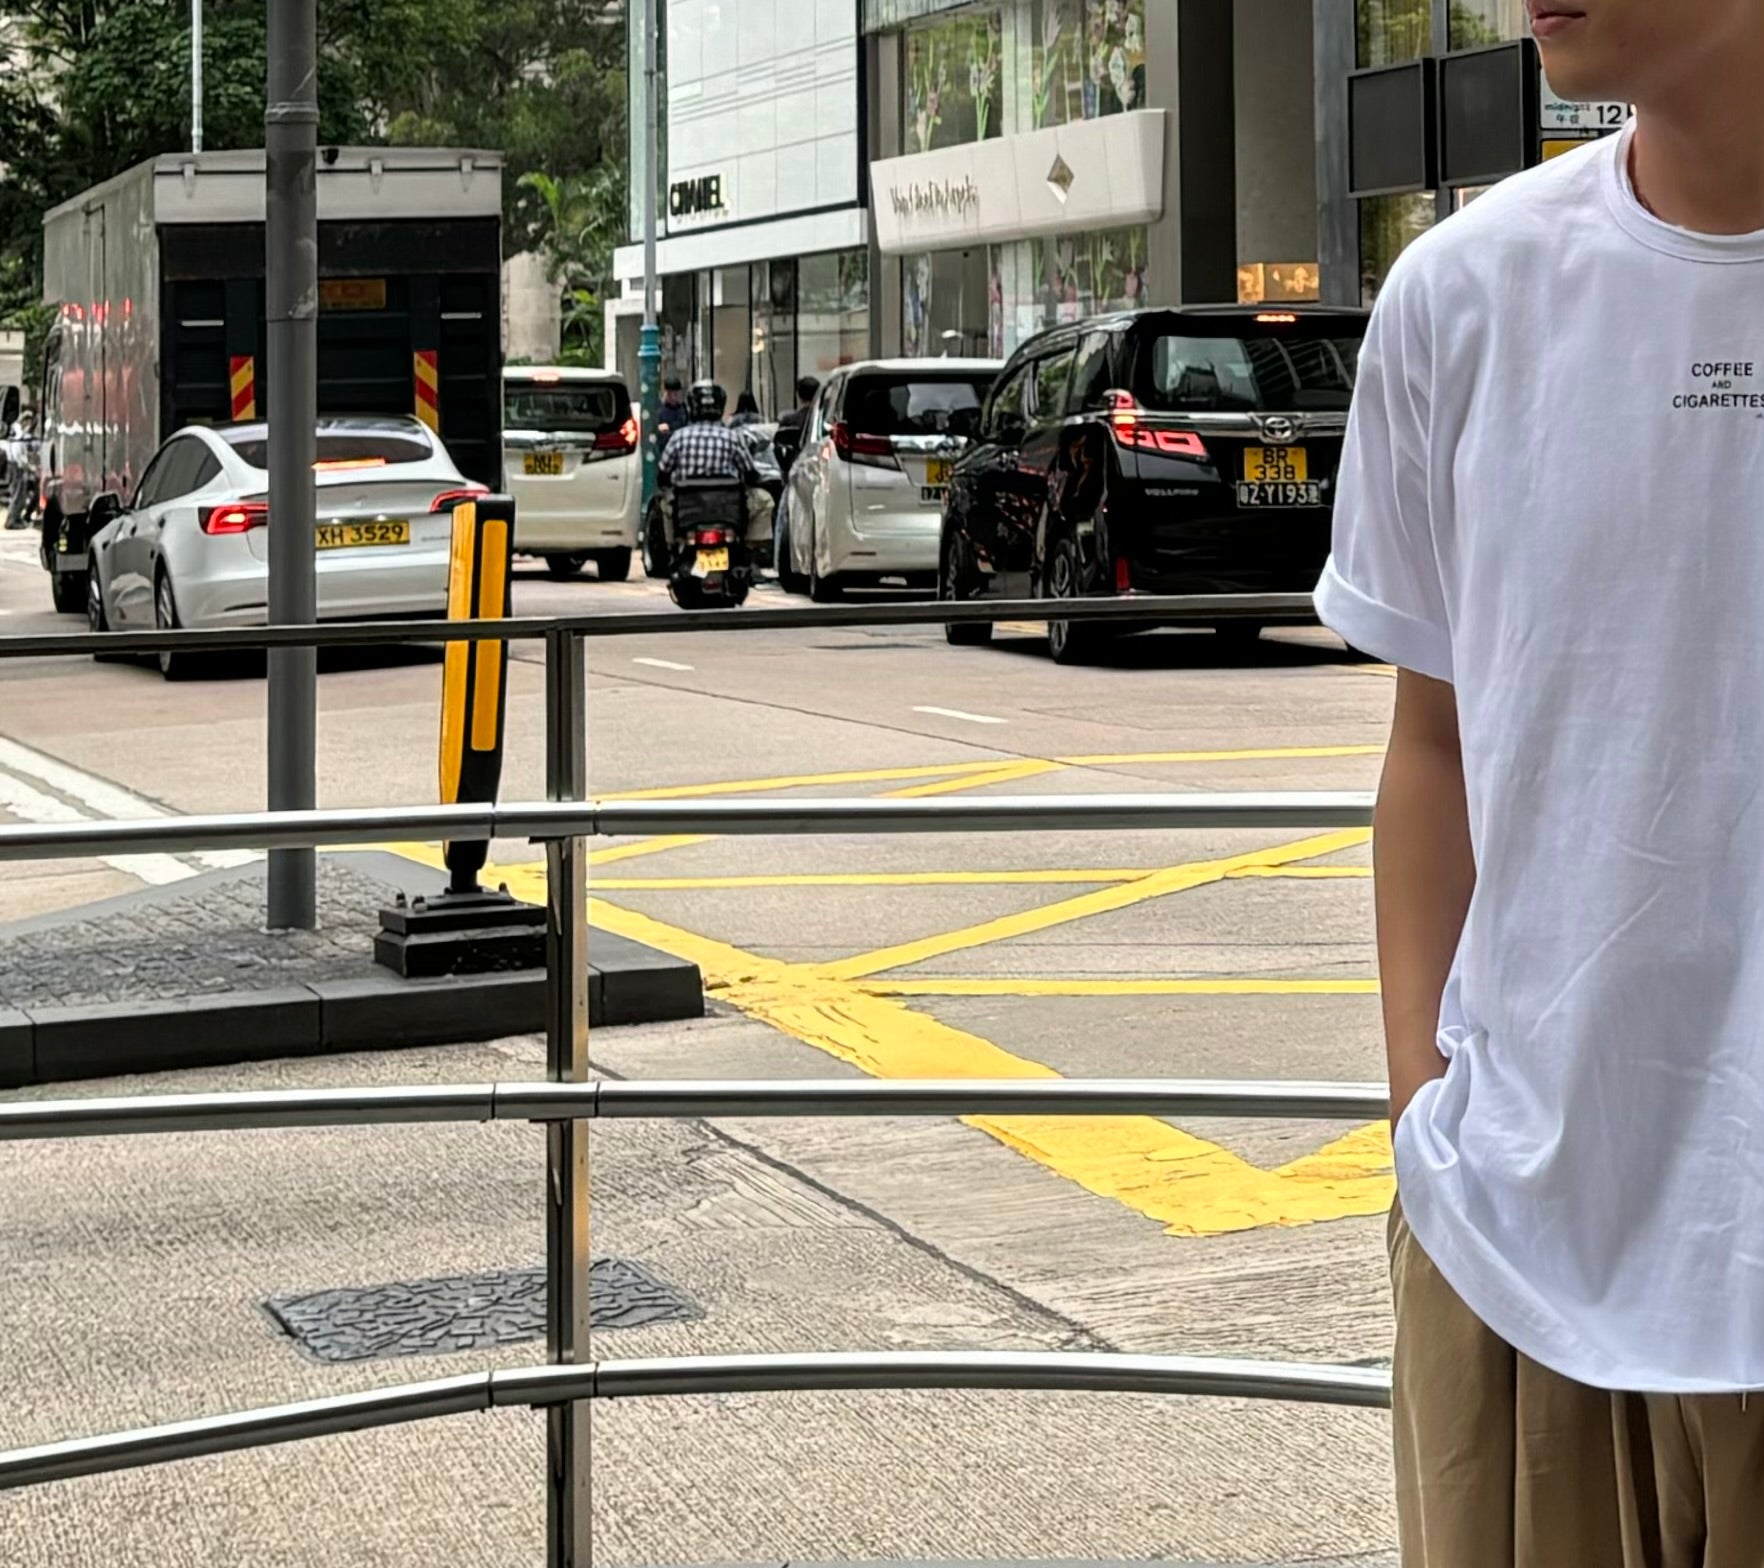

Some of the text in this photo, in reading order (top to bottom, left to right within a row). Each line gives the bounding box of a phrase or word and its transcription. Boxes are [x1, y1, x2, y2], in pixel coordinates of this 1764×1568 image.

[1597, 104, 1621, 124] 12
[1690, 362, 1754, 378] COFFEE
[1711, 380, 1732, 390] AND
[1262, 447, 1288, 466] BR
[318, 524, 404, 545] XH 3529
